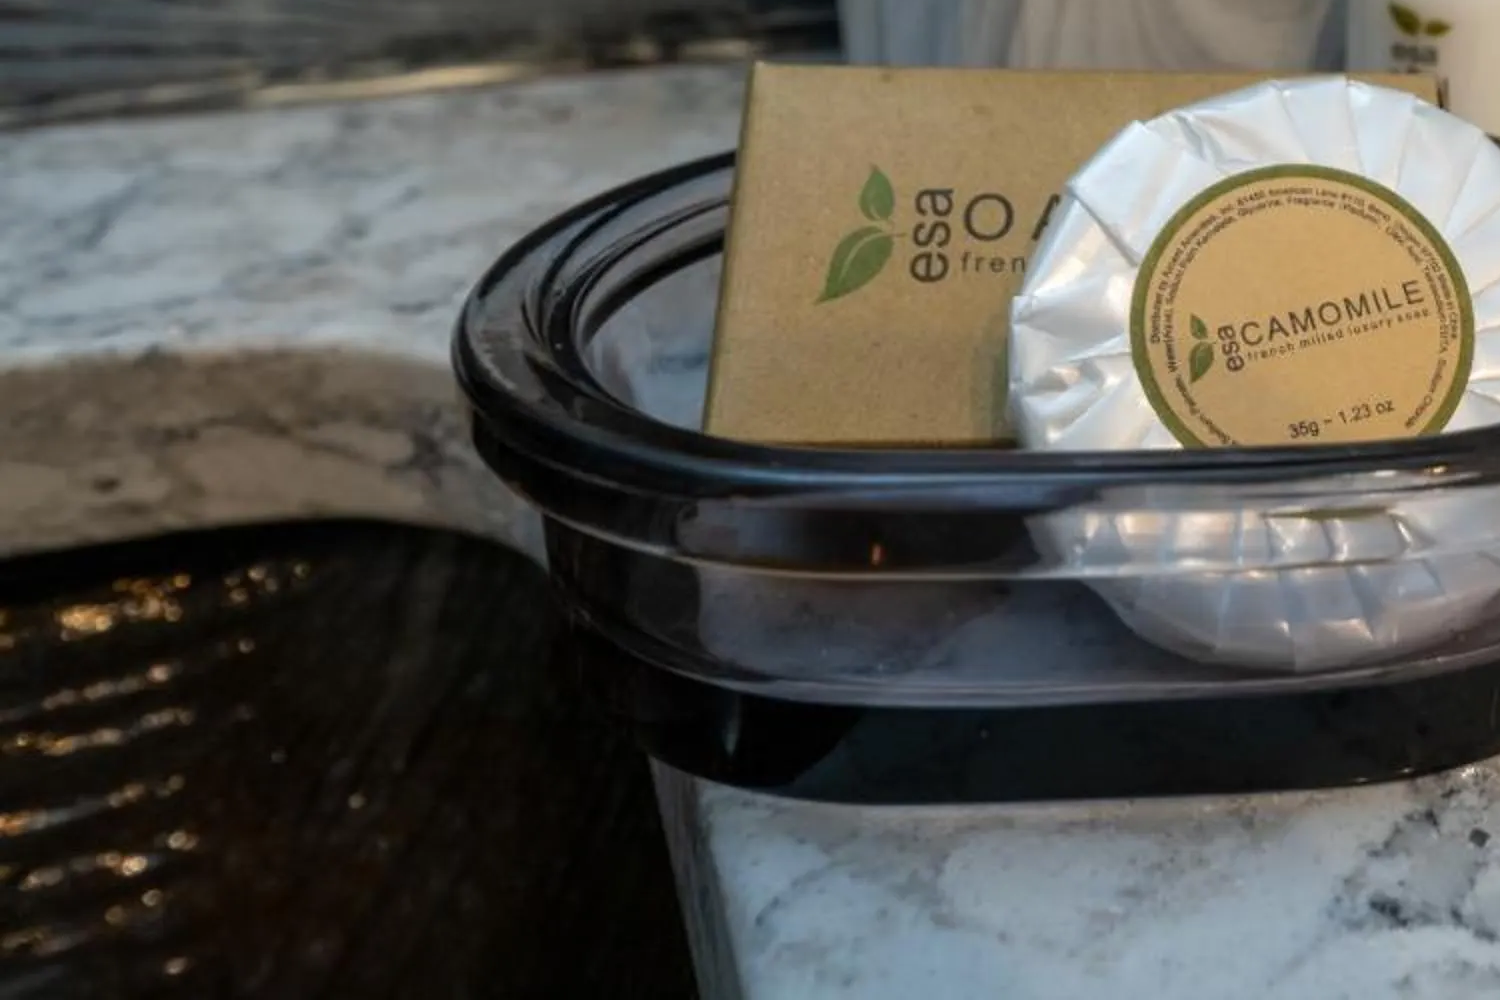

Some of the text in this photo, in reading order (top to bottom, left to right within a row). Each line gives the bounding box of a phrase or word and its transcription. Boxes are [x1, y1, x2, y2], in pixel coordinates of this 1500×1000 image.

[908, 187, 955, 284] esa
[1240, 279, 1425, 347] CAMOMILE
[1216, 324, 1245, 373] esa
[1247, 342, 1296, 362] french
[1288, 420, 1320, 439] 35g
[1338, 403, 1372, 425] 1.23
[1375, 400, 1396, 415] oz
